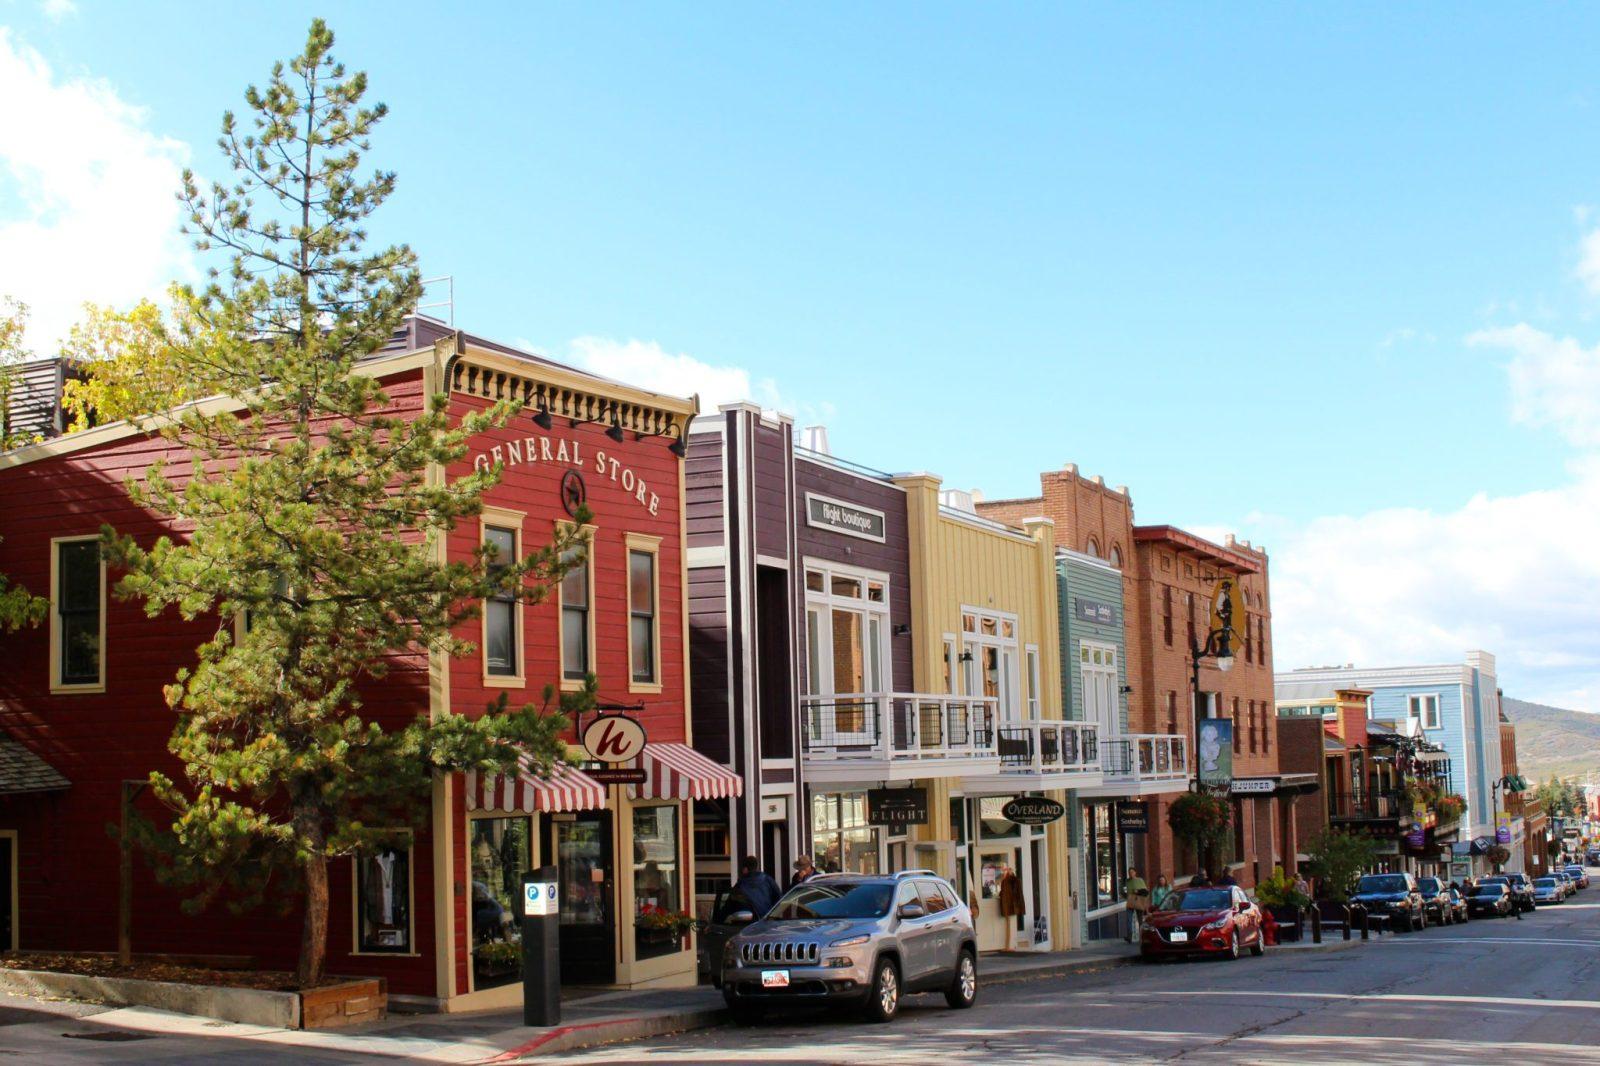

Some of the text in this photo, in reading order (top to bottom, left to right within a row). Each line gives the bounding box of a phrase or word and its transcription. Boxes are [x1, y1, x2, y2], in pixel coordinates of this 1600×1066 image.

[474, 437, 661, 517] GENERAL STORE
[596, 719, 632, 756] h
[872, 810, 926, 821] FLIGHT
[1008, 803, 1061, 815] OVERLAND
